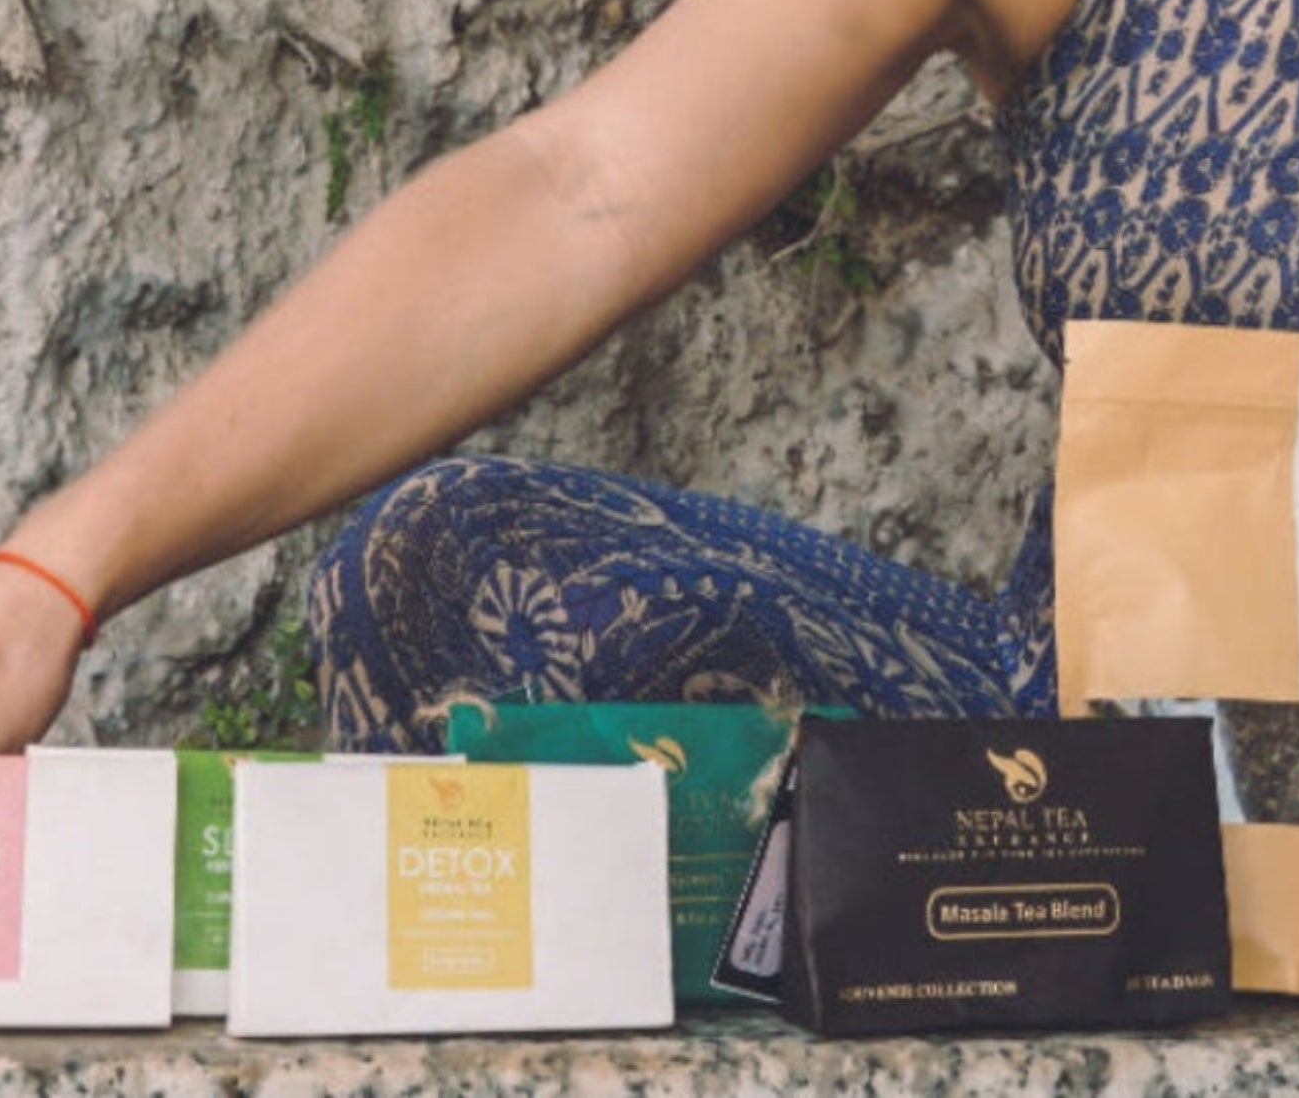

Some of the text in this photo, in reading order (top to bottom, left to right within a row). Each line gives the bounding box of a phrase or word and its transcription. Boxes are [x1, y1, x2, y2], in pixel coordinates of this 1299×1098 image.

[955, 806, 1088, 831] NEPAL TEA
[398, 846, 518, 880] DETOX
[940, 899, 1106, 923] Masala Tea Blend
[917, 979, 1017, 999] COLLECTION
